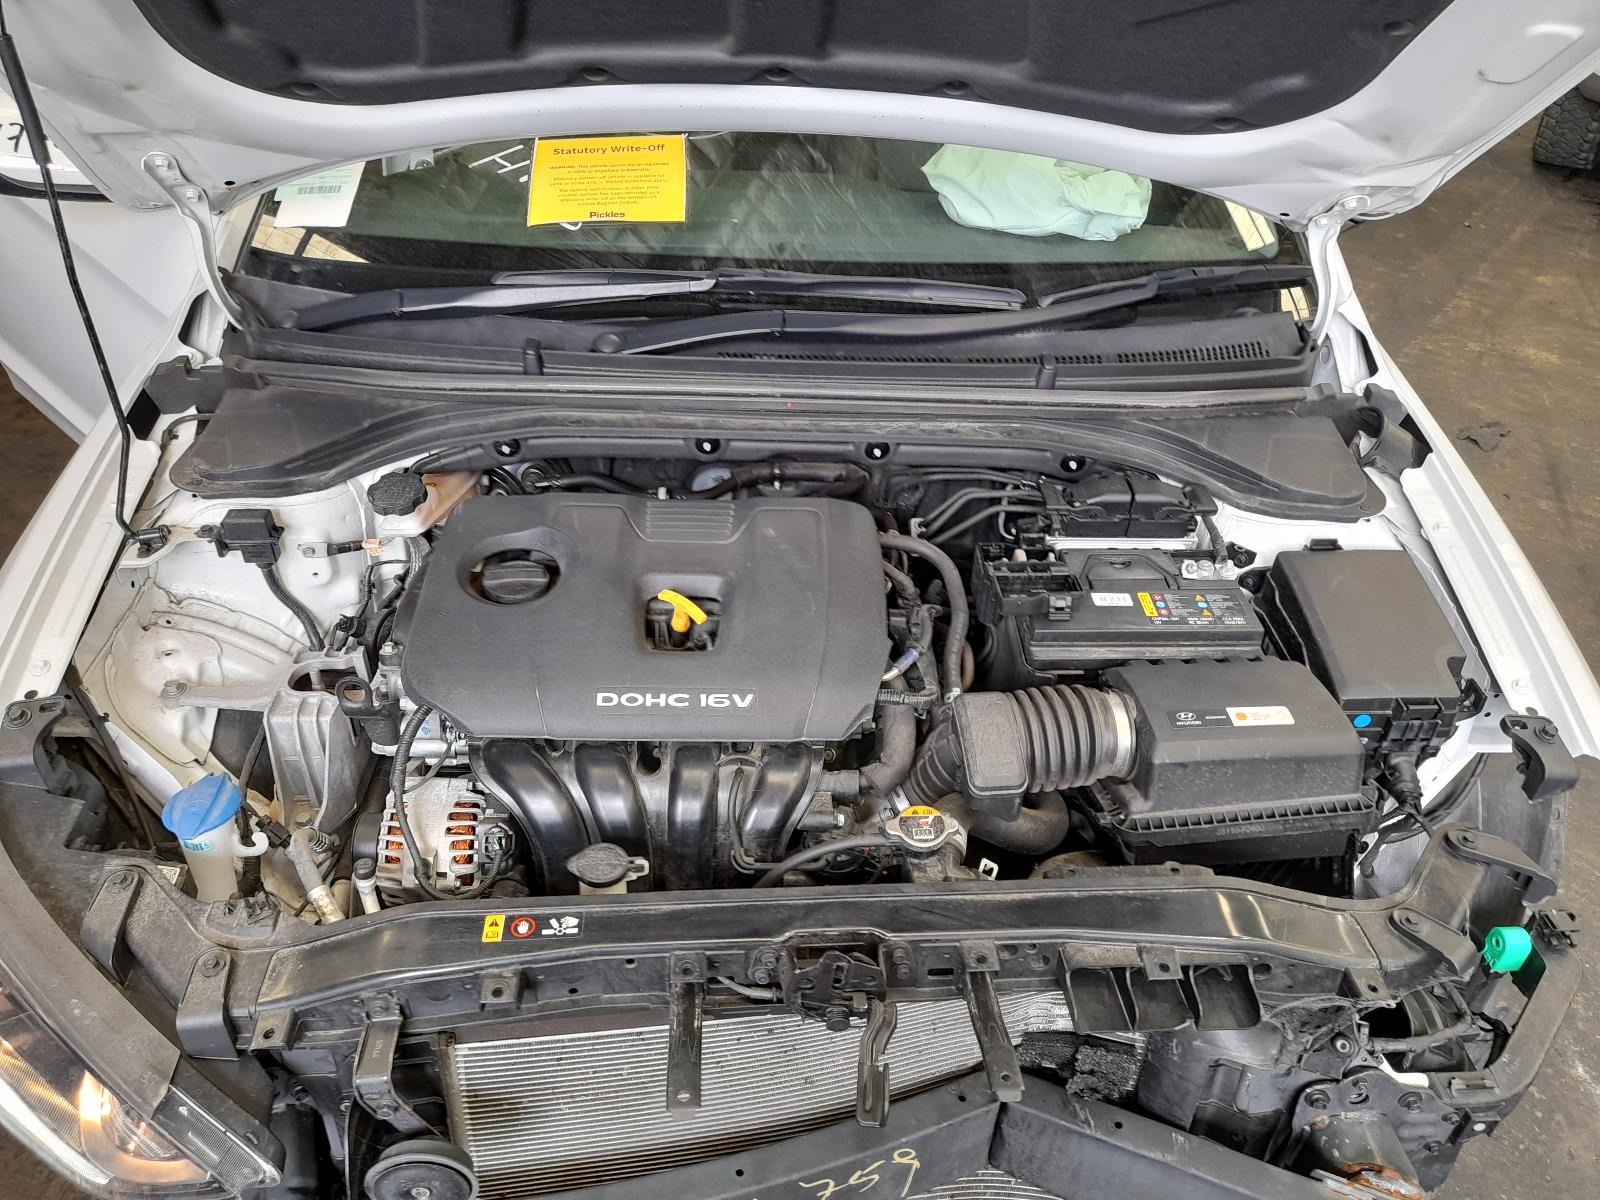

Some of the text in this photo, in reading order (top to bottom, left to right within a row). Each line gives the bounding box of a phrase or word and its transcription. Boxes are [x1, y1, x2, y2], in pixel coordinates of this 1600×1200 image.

[553, 143, 666, 155] Statutory Write-Off
[589, 210, 626, 219] Pickles
[595, 692, 755, 708] DOHC 16V
